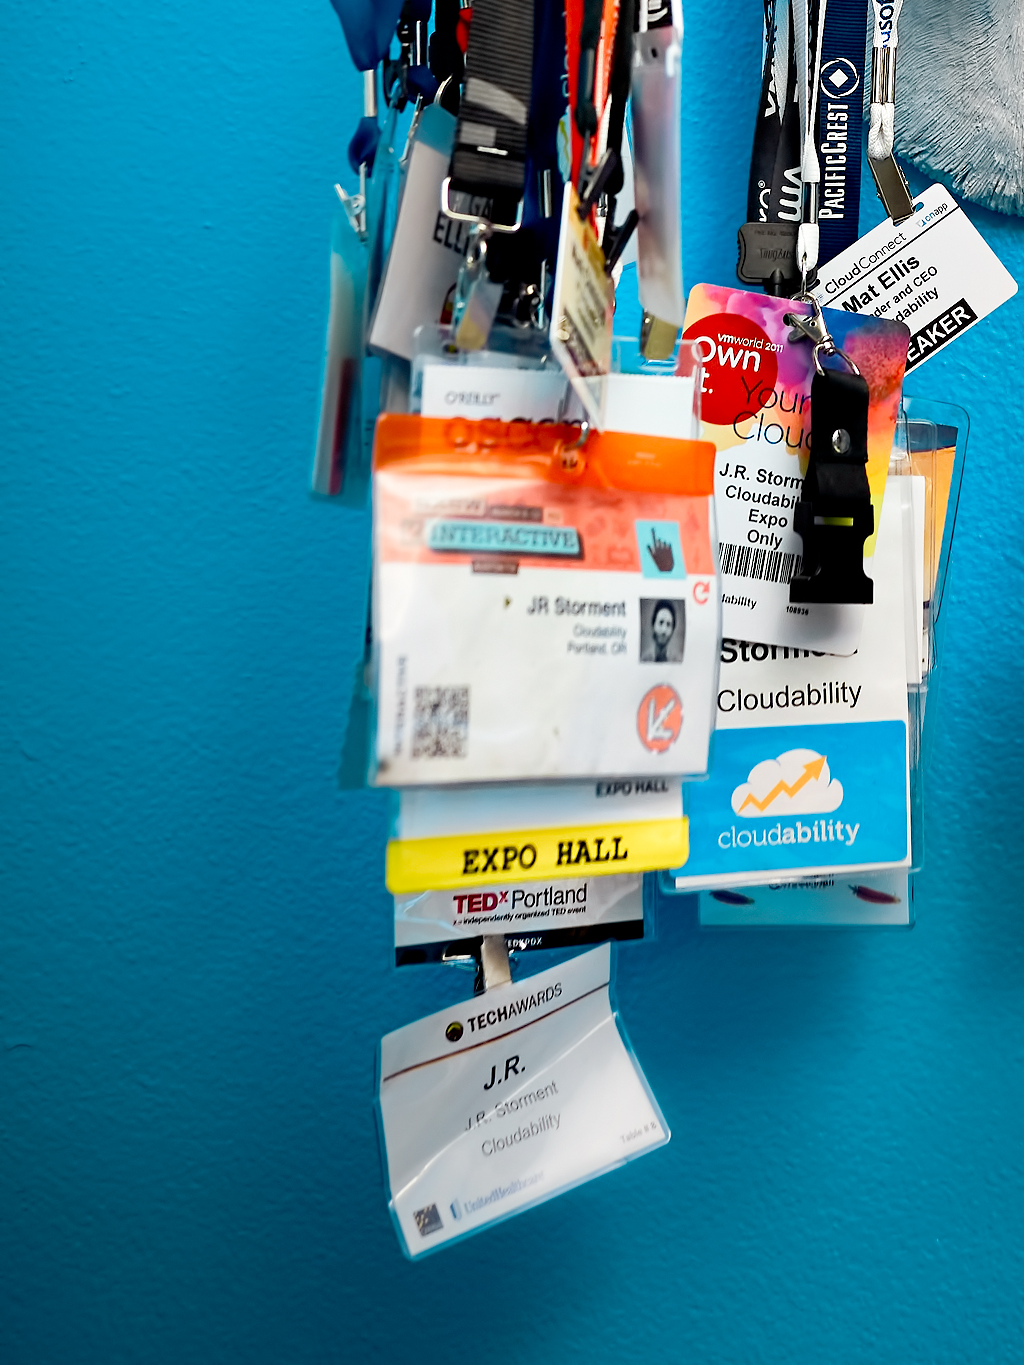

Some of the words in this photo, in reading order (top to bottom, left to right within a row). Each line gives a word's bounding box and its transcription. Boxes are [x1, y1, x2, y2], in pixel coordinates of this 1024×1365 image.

[842, 282, 880, 314] Mat
[876, 254, 921, 291] Ellis
[893, 286, 912, 307] and
[912, 265, 938, 292] CEO
[717, 333, 763, 350] vmworld
[765, 342, 784, 353] 2011
[907, 304, 973, 363] EAKER
[691, 336, 761, 372] Own
[719, 463, 750, 481] J.R.
[756, 468, 804, 490] Storm
[748, 509, 788, 528] Expo
[747, 529, 783, 550] Only
[527, 596, 549, 616] JR
[555, 598, 626, 617] Storment
[717, 681, 862, 713] Cloudability
[595, 780, 632, 798] EXPO
[636, 778, 668, 794] HALL
[717, 820, 861, 849] cloudability
[461, 844, 538, 875] EXPO
[556, 837, 628, 867] HALL
[551, 908, 566, 916] TED
[483, 1055, 526, 1090] J.R.
[465, 1111, 492, 1132] J.R.
[495, 1080, 559, 1118] Storment
[481, 1113, 561, 1158] Cloudability
